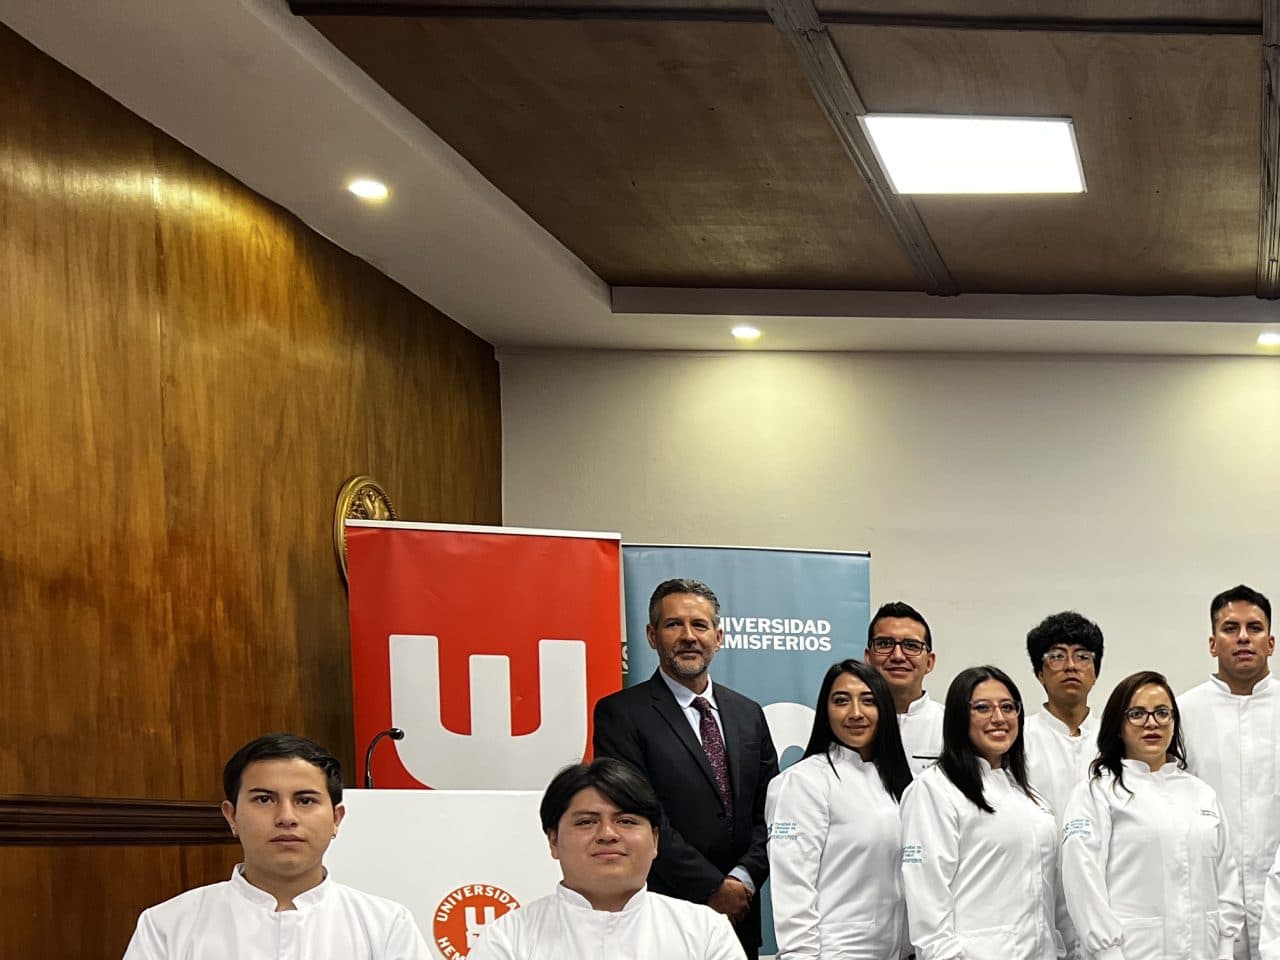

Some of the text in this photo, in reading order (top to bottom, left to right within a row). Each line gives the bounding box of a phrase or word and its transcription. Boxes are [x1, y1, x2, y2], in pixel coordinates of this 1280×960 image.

[719, 617, 831, 635] IVERSIDAD
[720, 633, 832, 651] MISFERIOS
[436, 885, 518, 922] UNIVERSIDA
